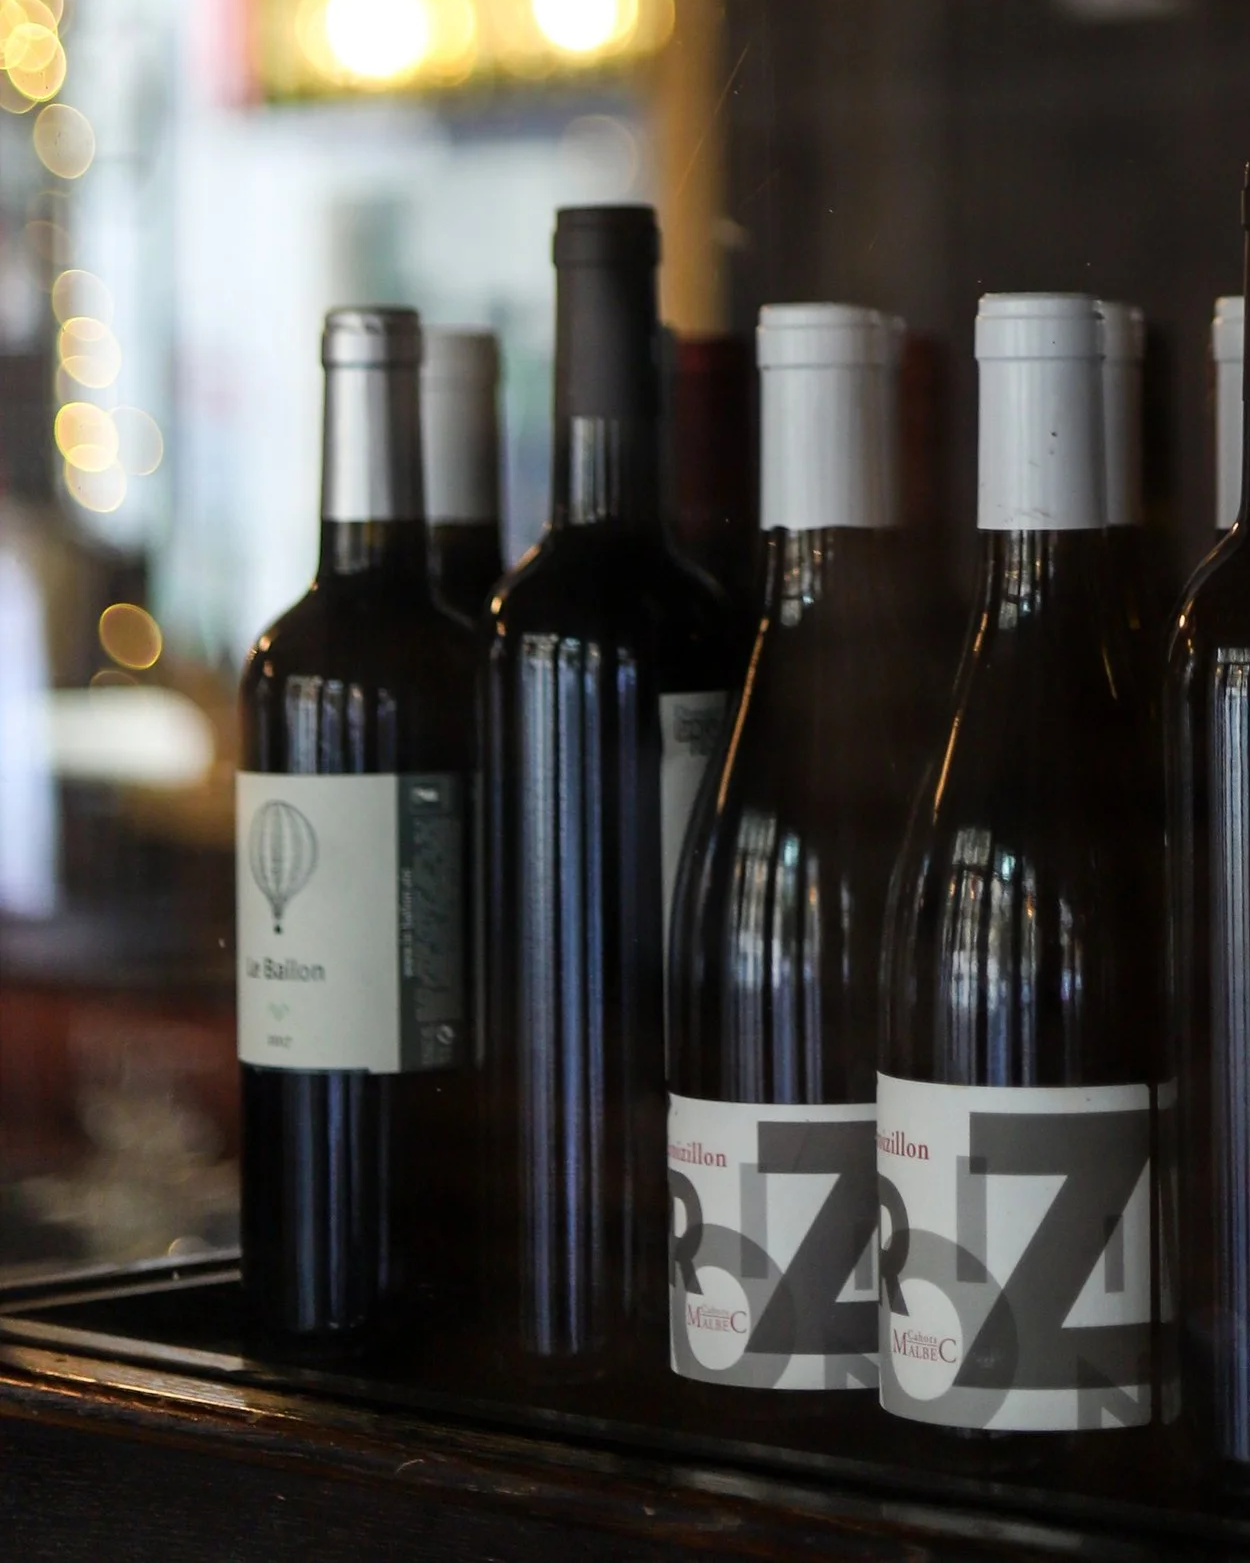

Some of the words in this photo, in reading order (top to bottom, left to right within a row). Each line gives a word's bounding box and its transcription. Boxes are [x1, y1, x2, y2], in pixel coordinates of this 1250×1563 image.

[263, 955, 327, 983] Ballon
[686, 1303, 748, 1334] MALBEC
[892, 1327, 957, 1364] MALBEC
[907, 1329, 938, 1345] Cahors
